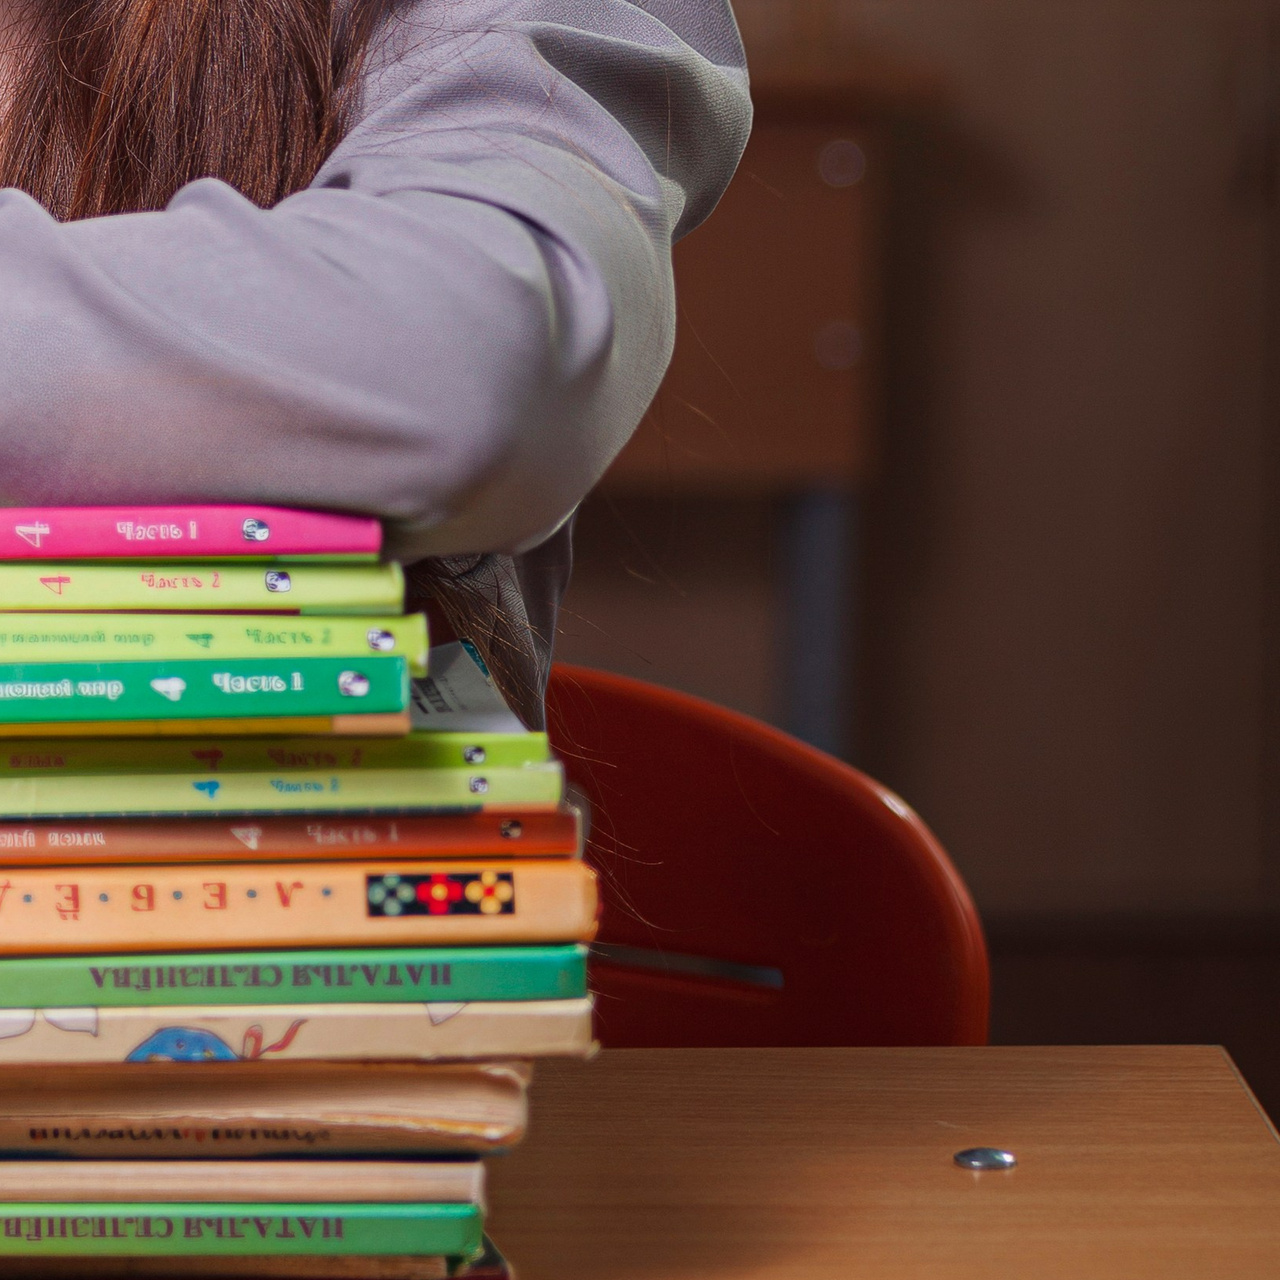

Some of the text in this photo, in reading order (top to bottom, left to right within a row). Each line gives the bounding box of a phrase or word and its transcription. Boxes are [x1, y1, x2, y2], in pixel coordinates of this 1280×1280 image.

[213, 672, 286, 693] Часть
[292, 963, 451, 987] НАТАЛЬЯ
[184, 1217, 344, 1239] НАТАЛЬЯ
